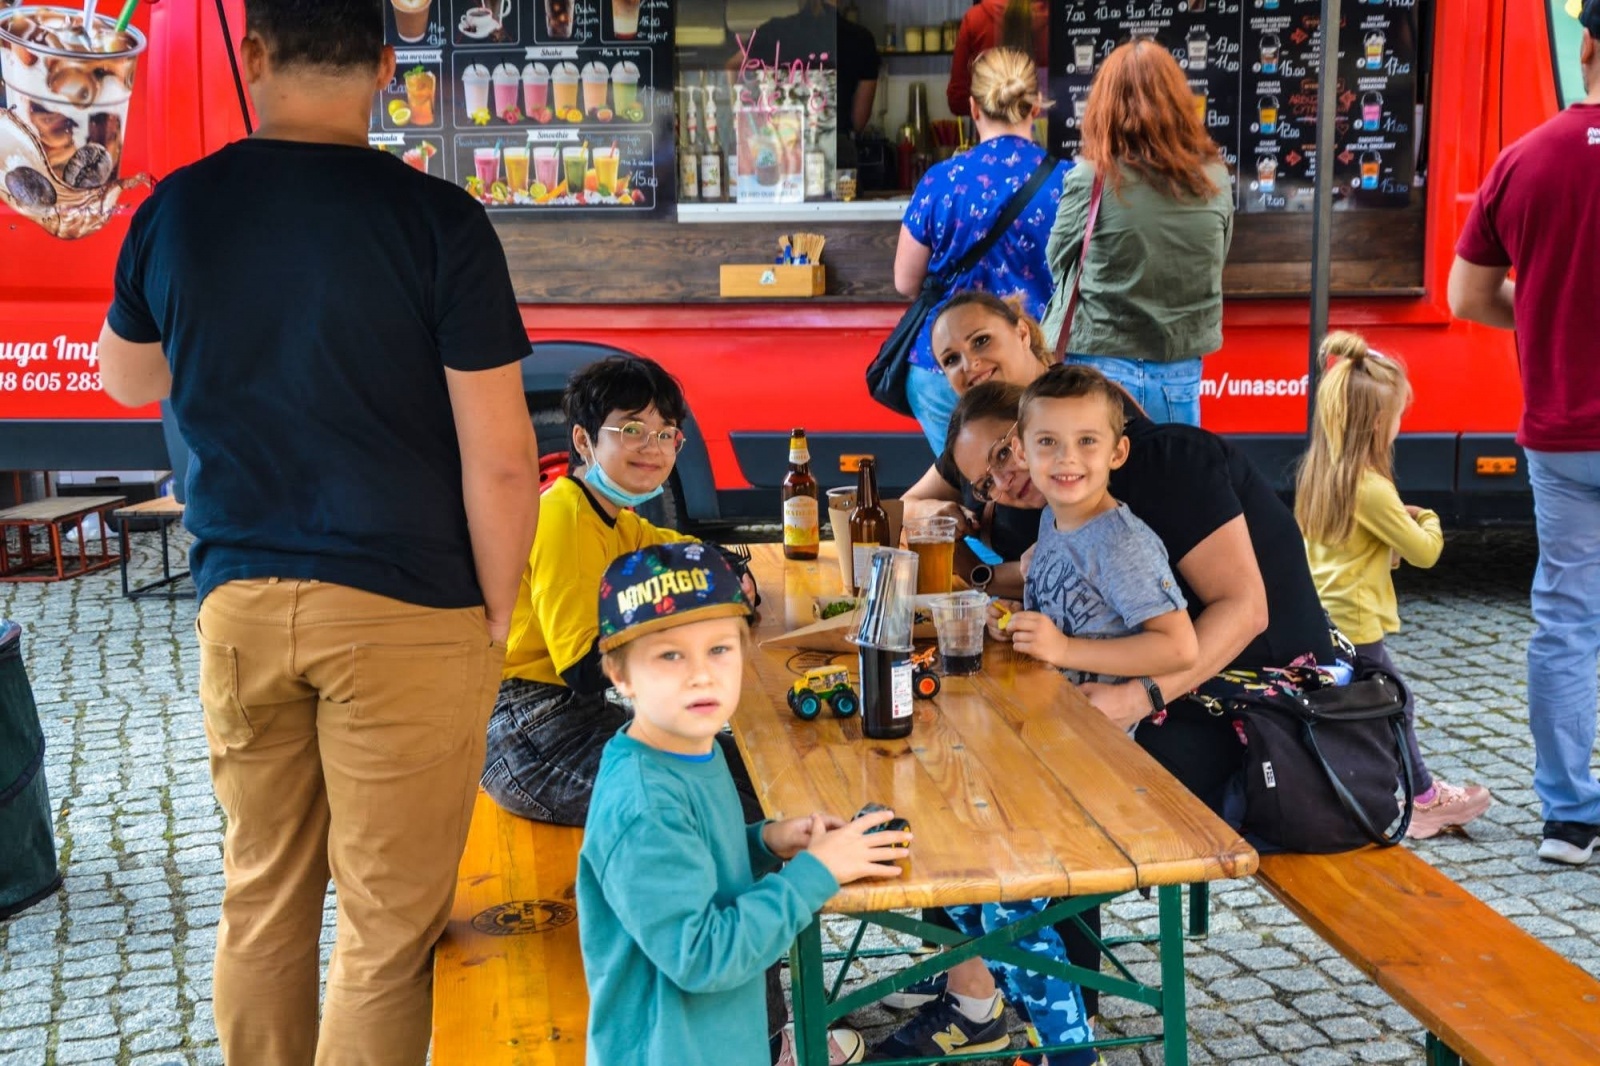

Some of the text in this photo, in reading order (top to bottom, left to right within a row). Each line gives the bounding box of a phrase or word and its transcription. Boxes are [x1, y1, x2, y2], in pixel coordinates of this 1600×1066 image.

[537, 131, 569, 140] Smoothie
[22, 371, 61, 391] 605
[66, 371, 103, 391] 283
[616, 567, 709, 615] NINJAGO
